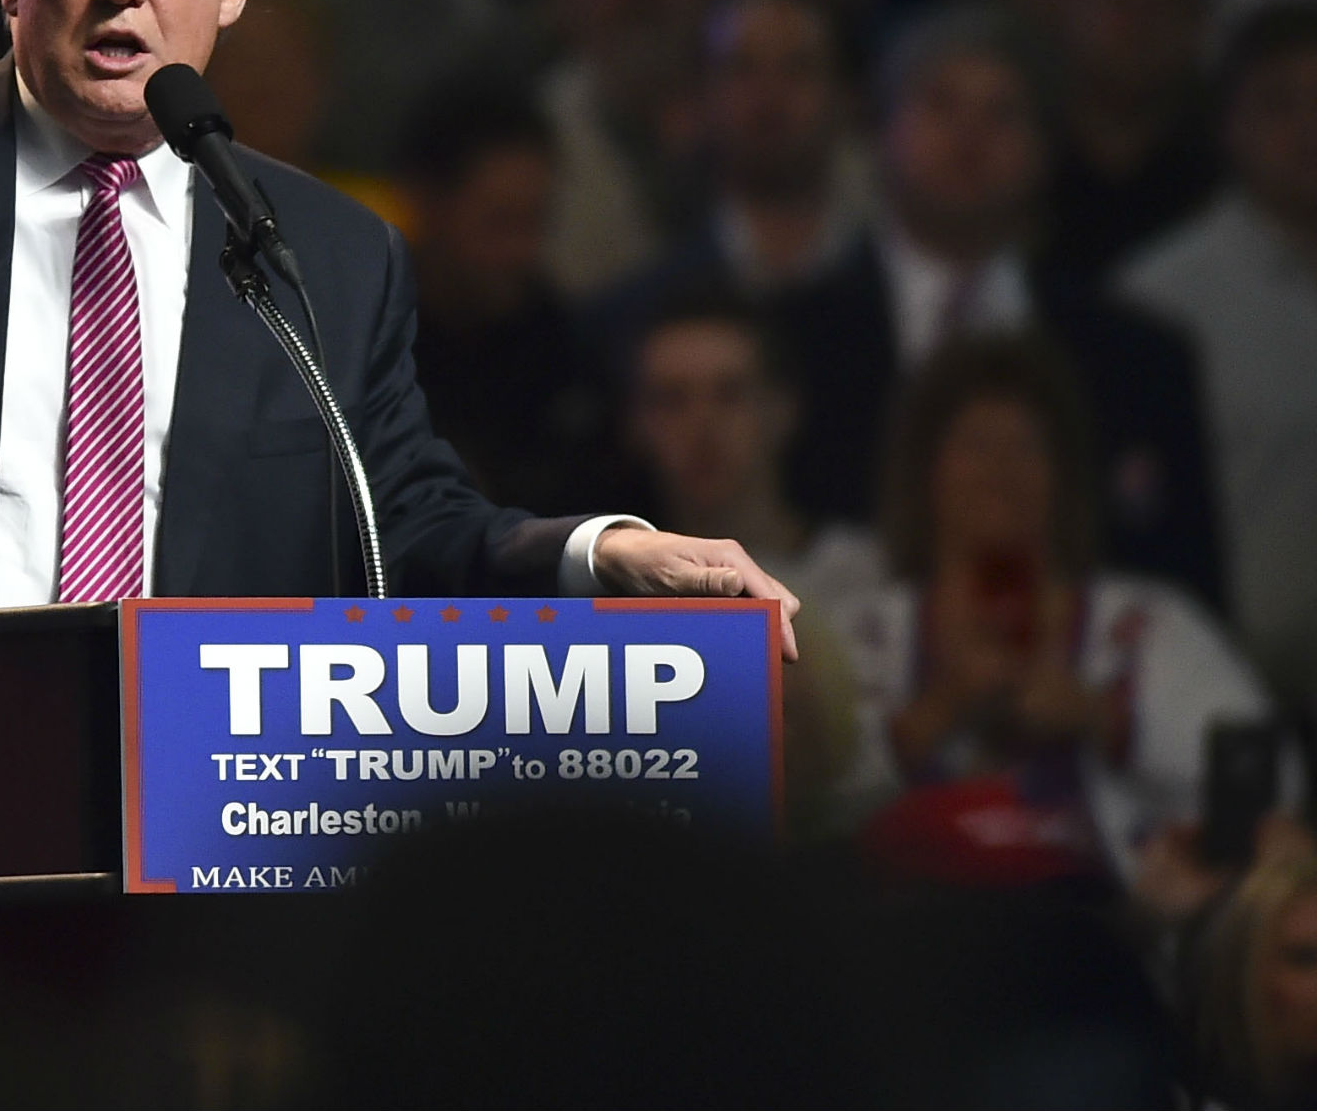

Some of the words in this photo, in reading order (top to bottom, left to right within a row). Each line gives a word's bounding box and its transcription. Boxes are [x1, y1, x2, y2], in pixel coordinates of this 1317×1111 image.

[199, 644, 705, 736] TRUMP
[211, 753, 306, 781] TEXT
[512, 754, 546, 780] to
[558, 748, 700, 780] 88022
[191, 866, 294, 889] MAKE
